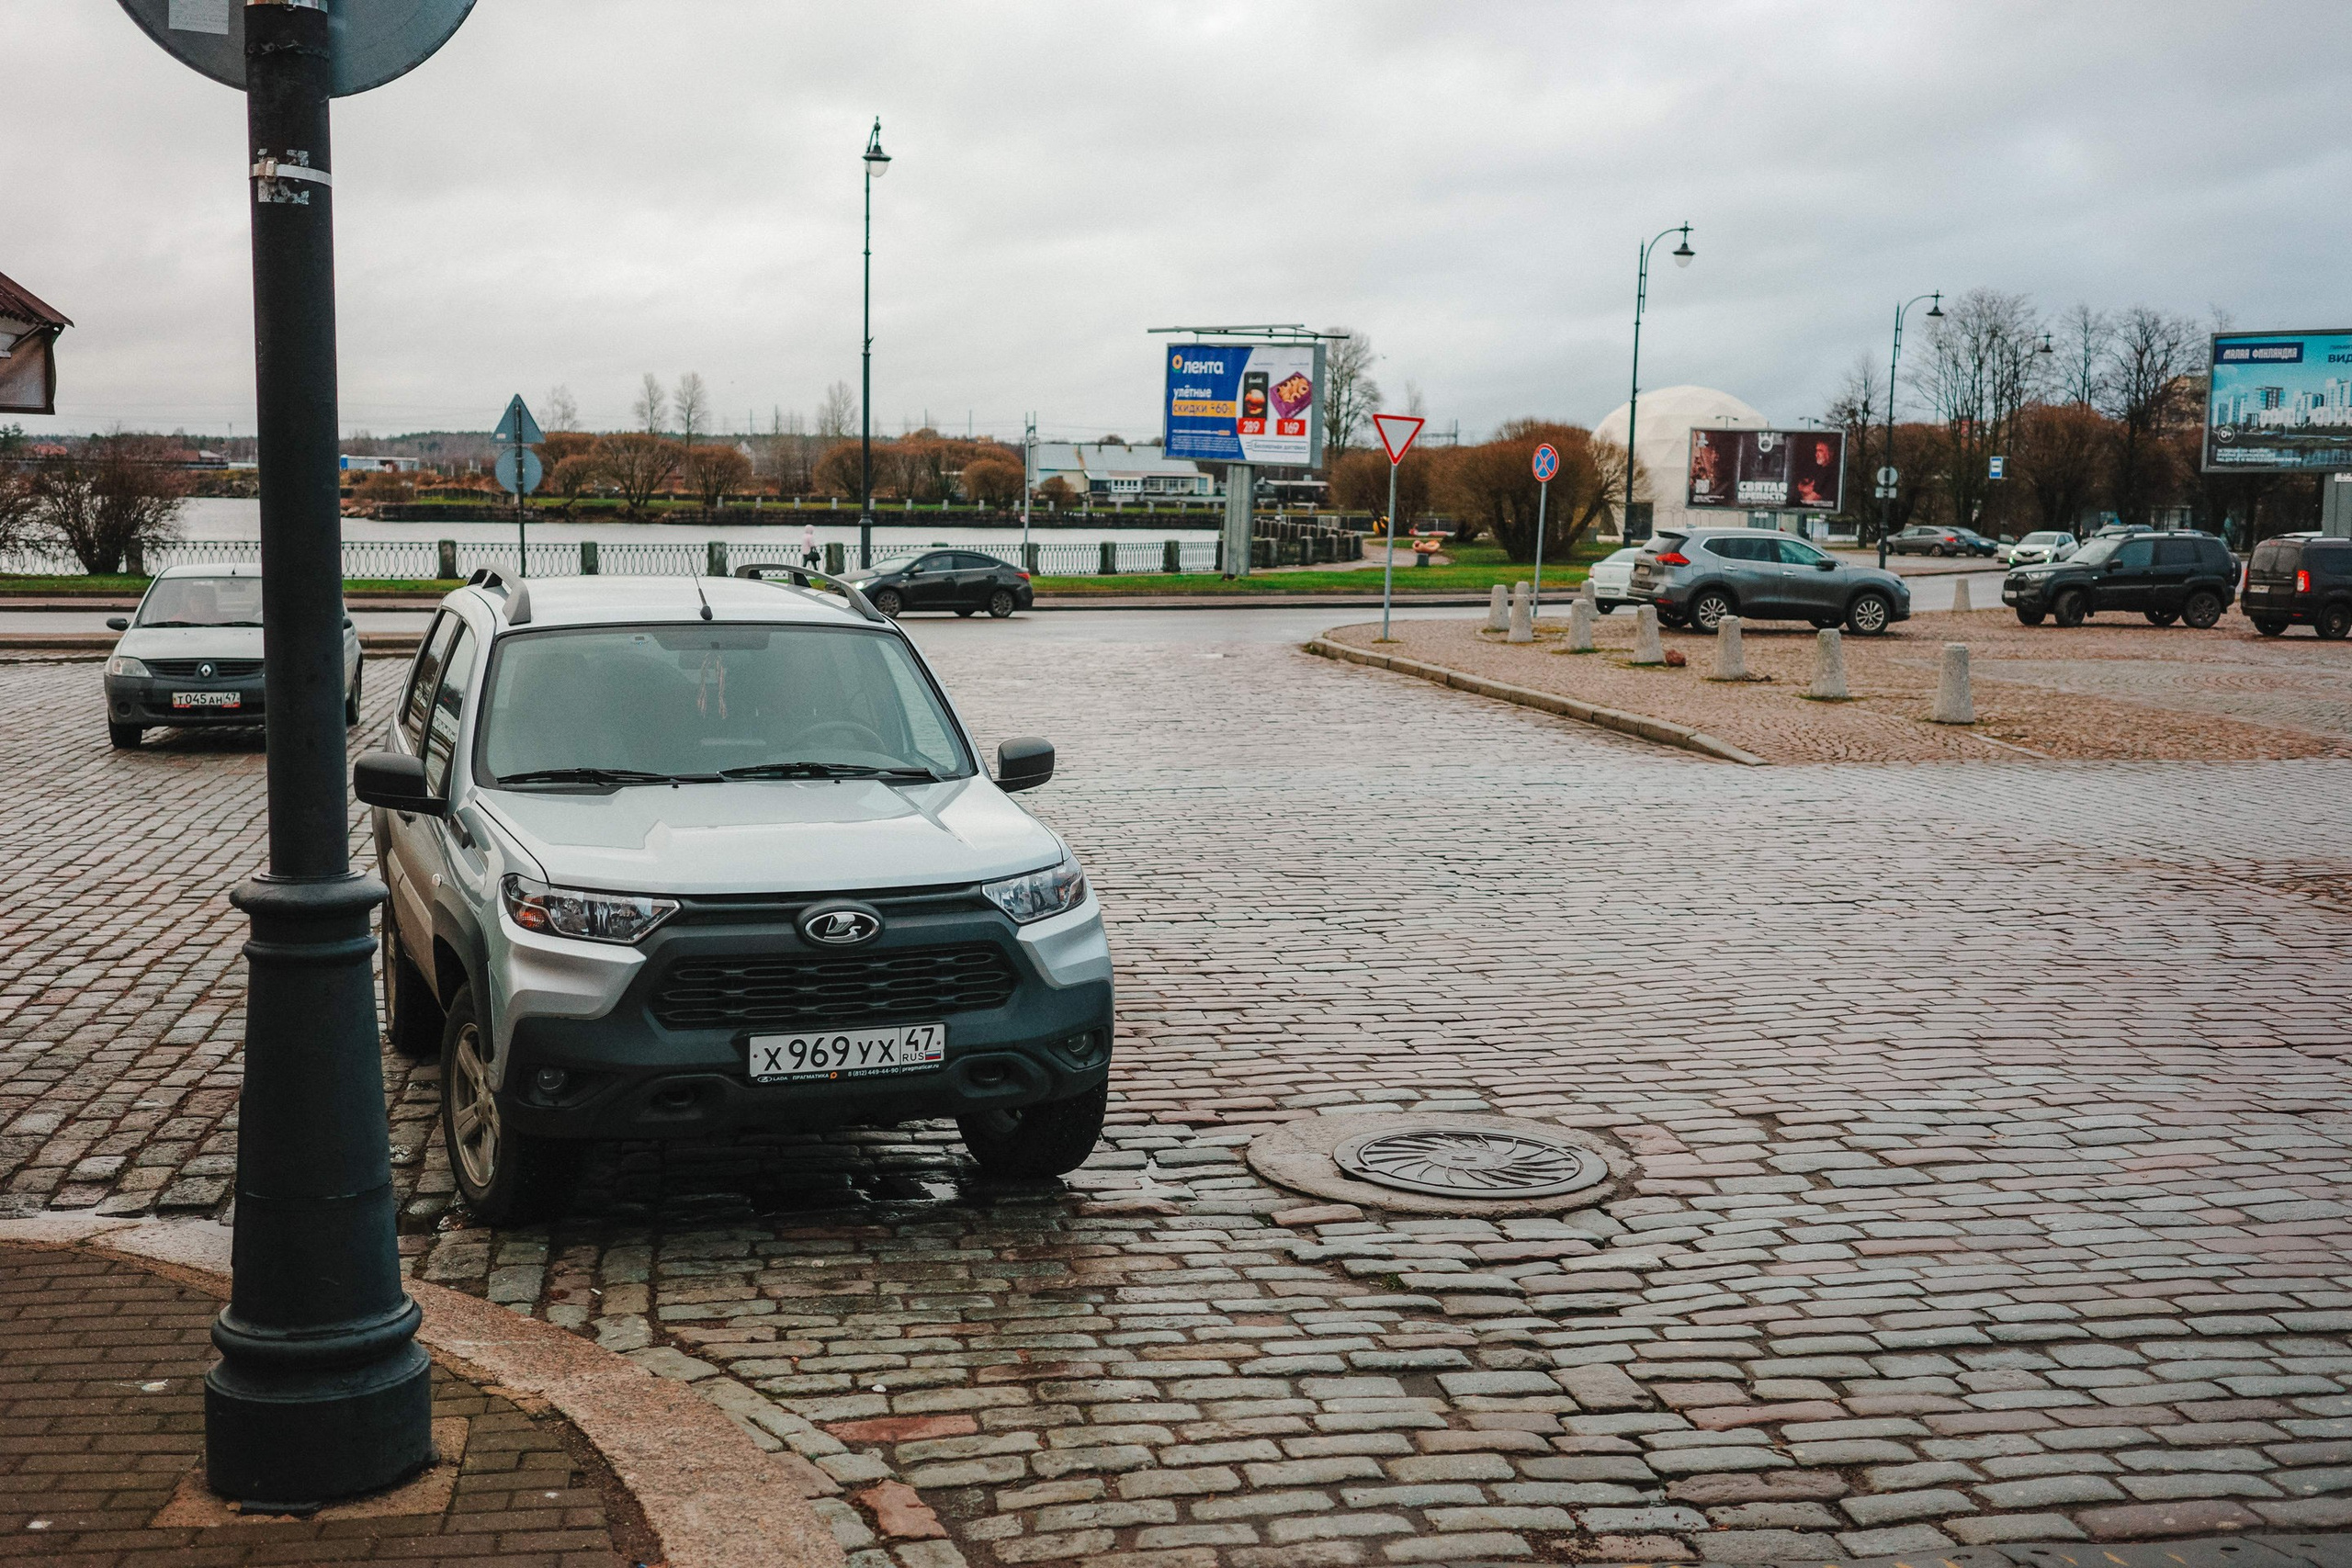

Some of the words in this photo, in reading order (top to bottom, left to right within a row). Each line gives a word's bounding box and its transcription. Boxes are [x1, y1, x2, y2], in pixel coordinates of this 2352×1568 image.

[2252, 347, 2298, 359] ФИНЛЯНДИЯ
[1182, 360, 1224, 374] лента
[1172, 384, 1213, 400] улётные
[1283, 421, 1300, 434] 169
[177, 694, 222, 705] Т045АН
[225, 693, 236, 702] 47
[763, 1035, 895, 1071] Х969УХ
[905, 1027, 934, 1052] 47
[902, 1052, 924, 1062] RUS
[867, 1067, 899, 1076] 449-44-90
[901, 1064, 940, 1073] pragmaticar.ru
